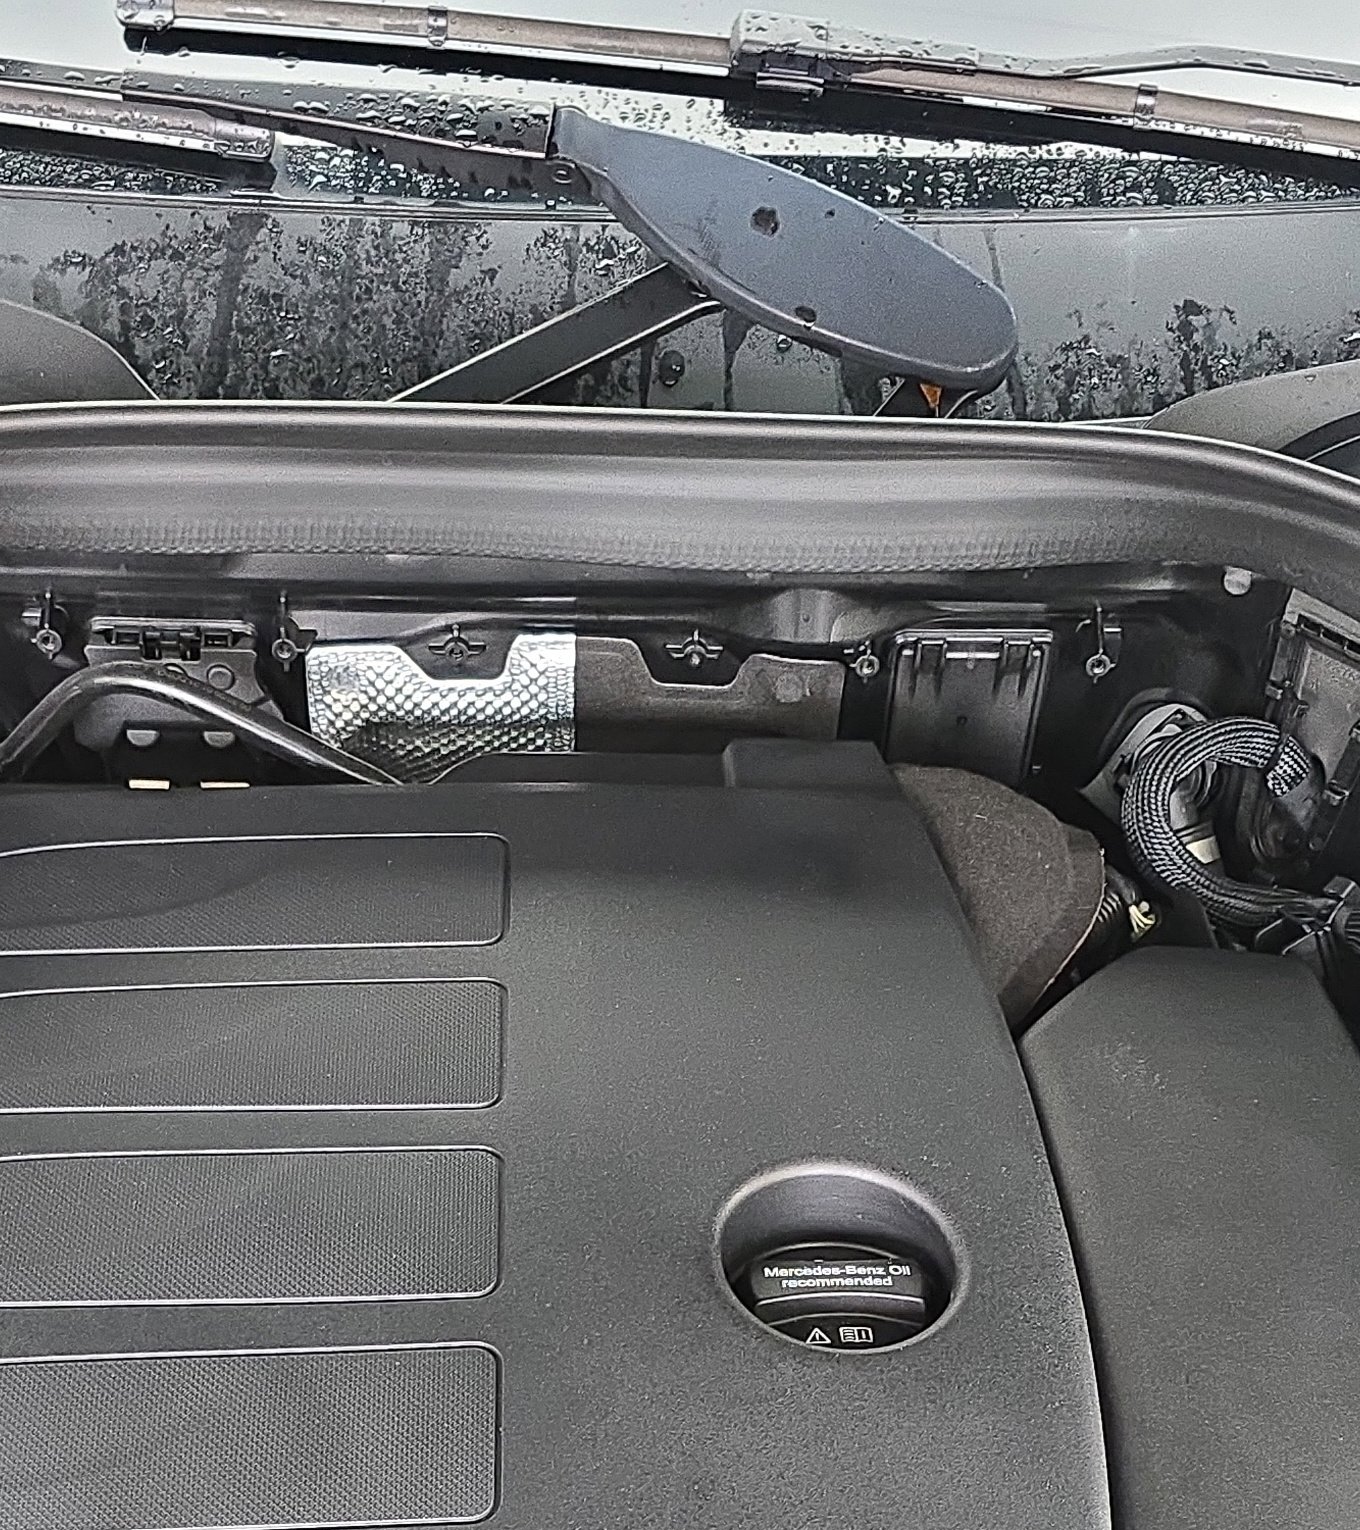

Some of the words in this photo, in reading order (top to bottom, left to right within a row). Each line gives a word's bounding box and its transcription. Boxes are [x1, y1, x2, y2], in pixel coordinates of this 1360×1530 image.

[763, 1266, 886, 1278] Mercedes-Benz
[889, 1265, 911, 1276] Oil
[781, 1276, 893, 1288] recommended
